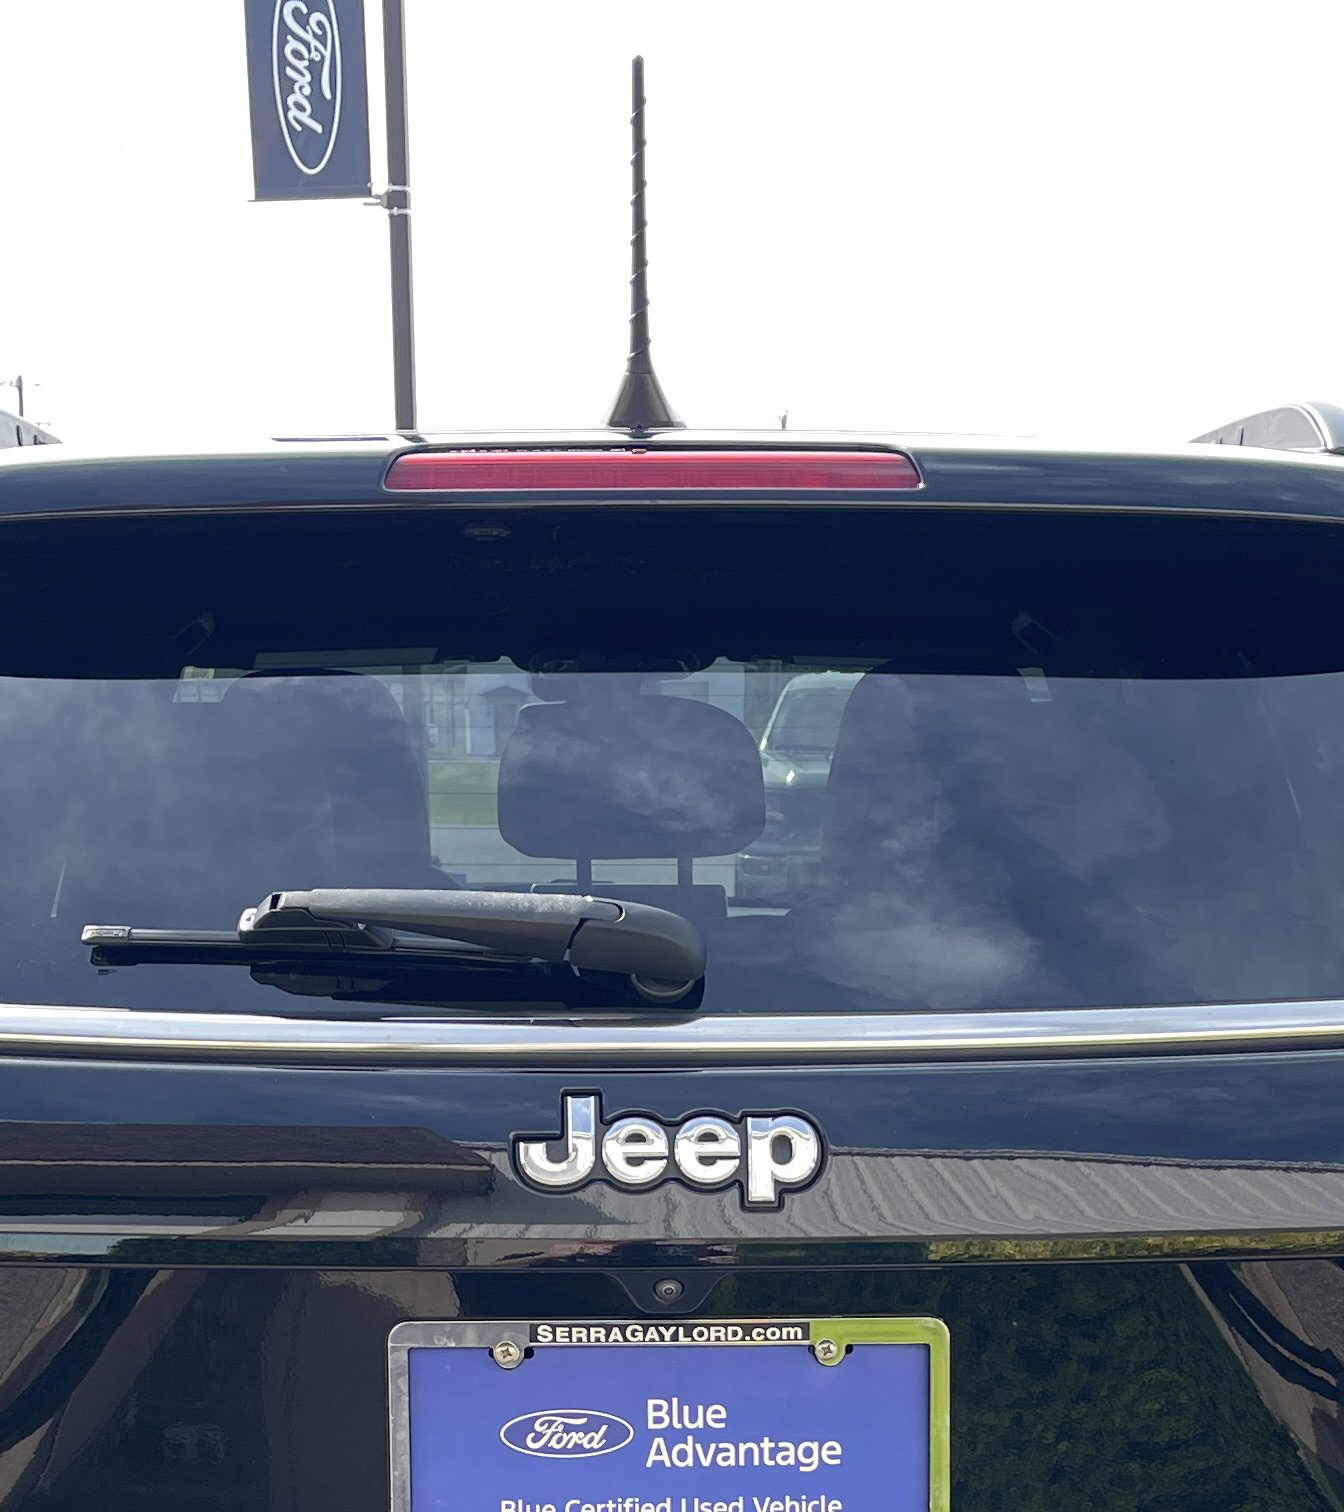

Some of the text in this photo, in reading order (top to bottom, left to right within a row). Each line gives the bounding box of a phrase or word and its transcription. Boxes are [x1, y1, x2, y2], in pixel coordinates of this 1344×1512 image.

[283, 0, 332, 133] Ford
[519, 1096, 818, 1202] Jeep
[646, 1397, 727, 1430] Blue
[526, 1416, 608, 1450] Ford
[645, 1436, 843, 1472] Advantage
